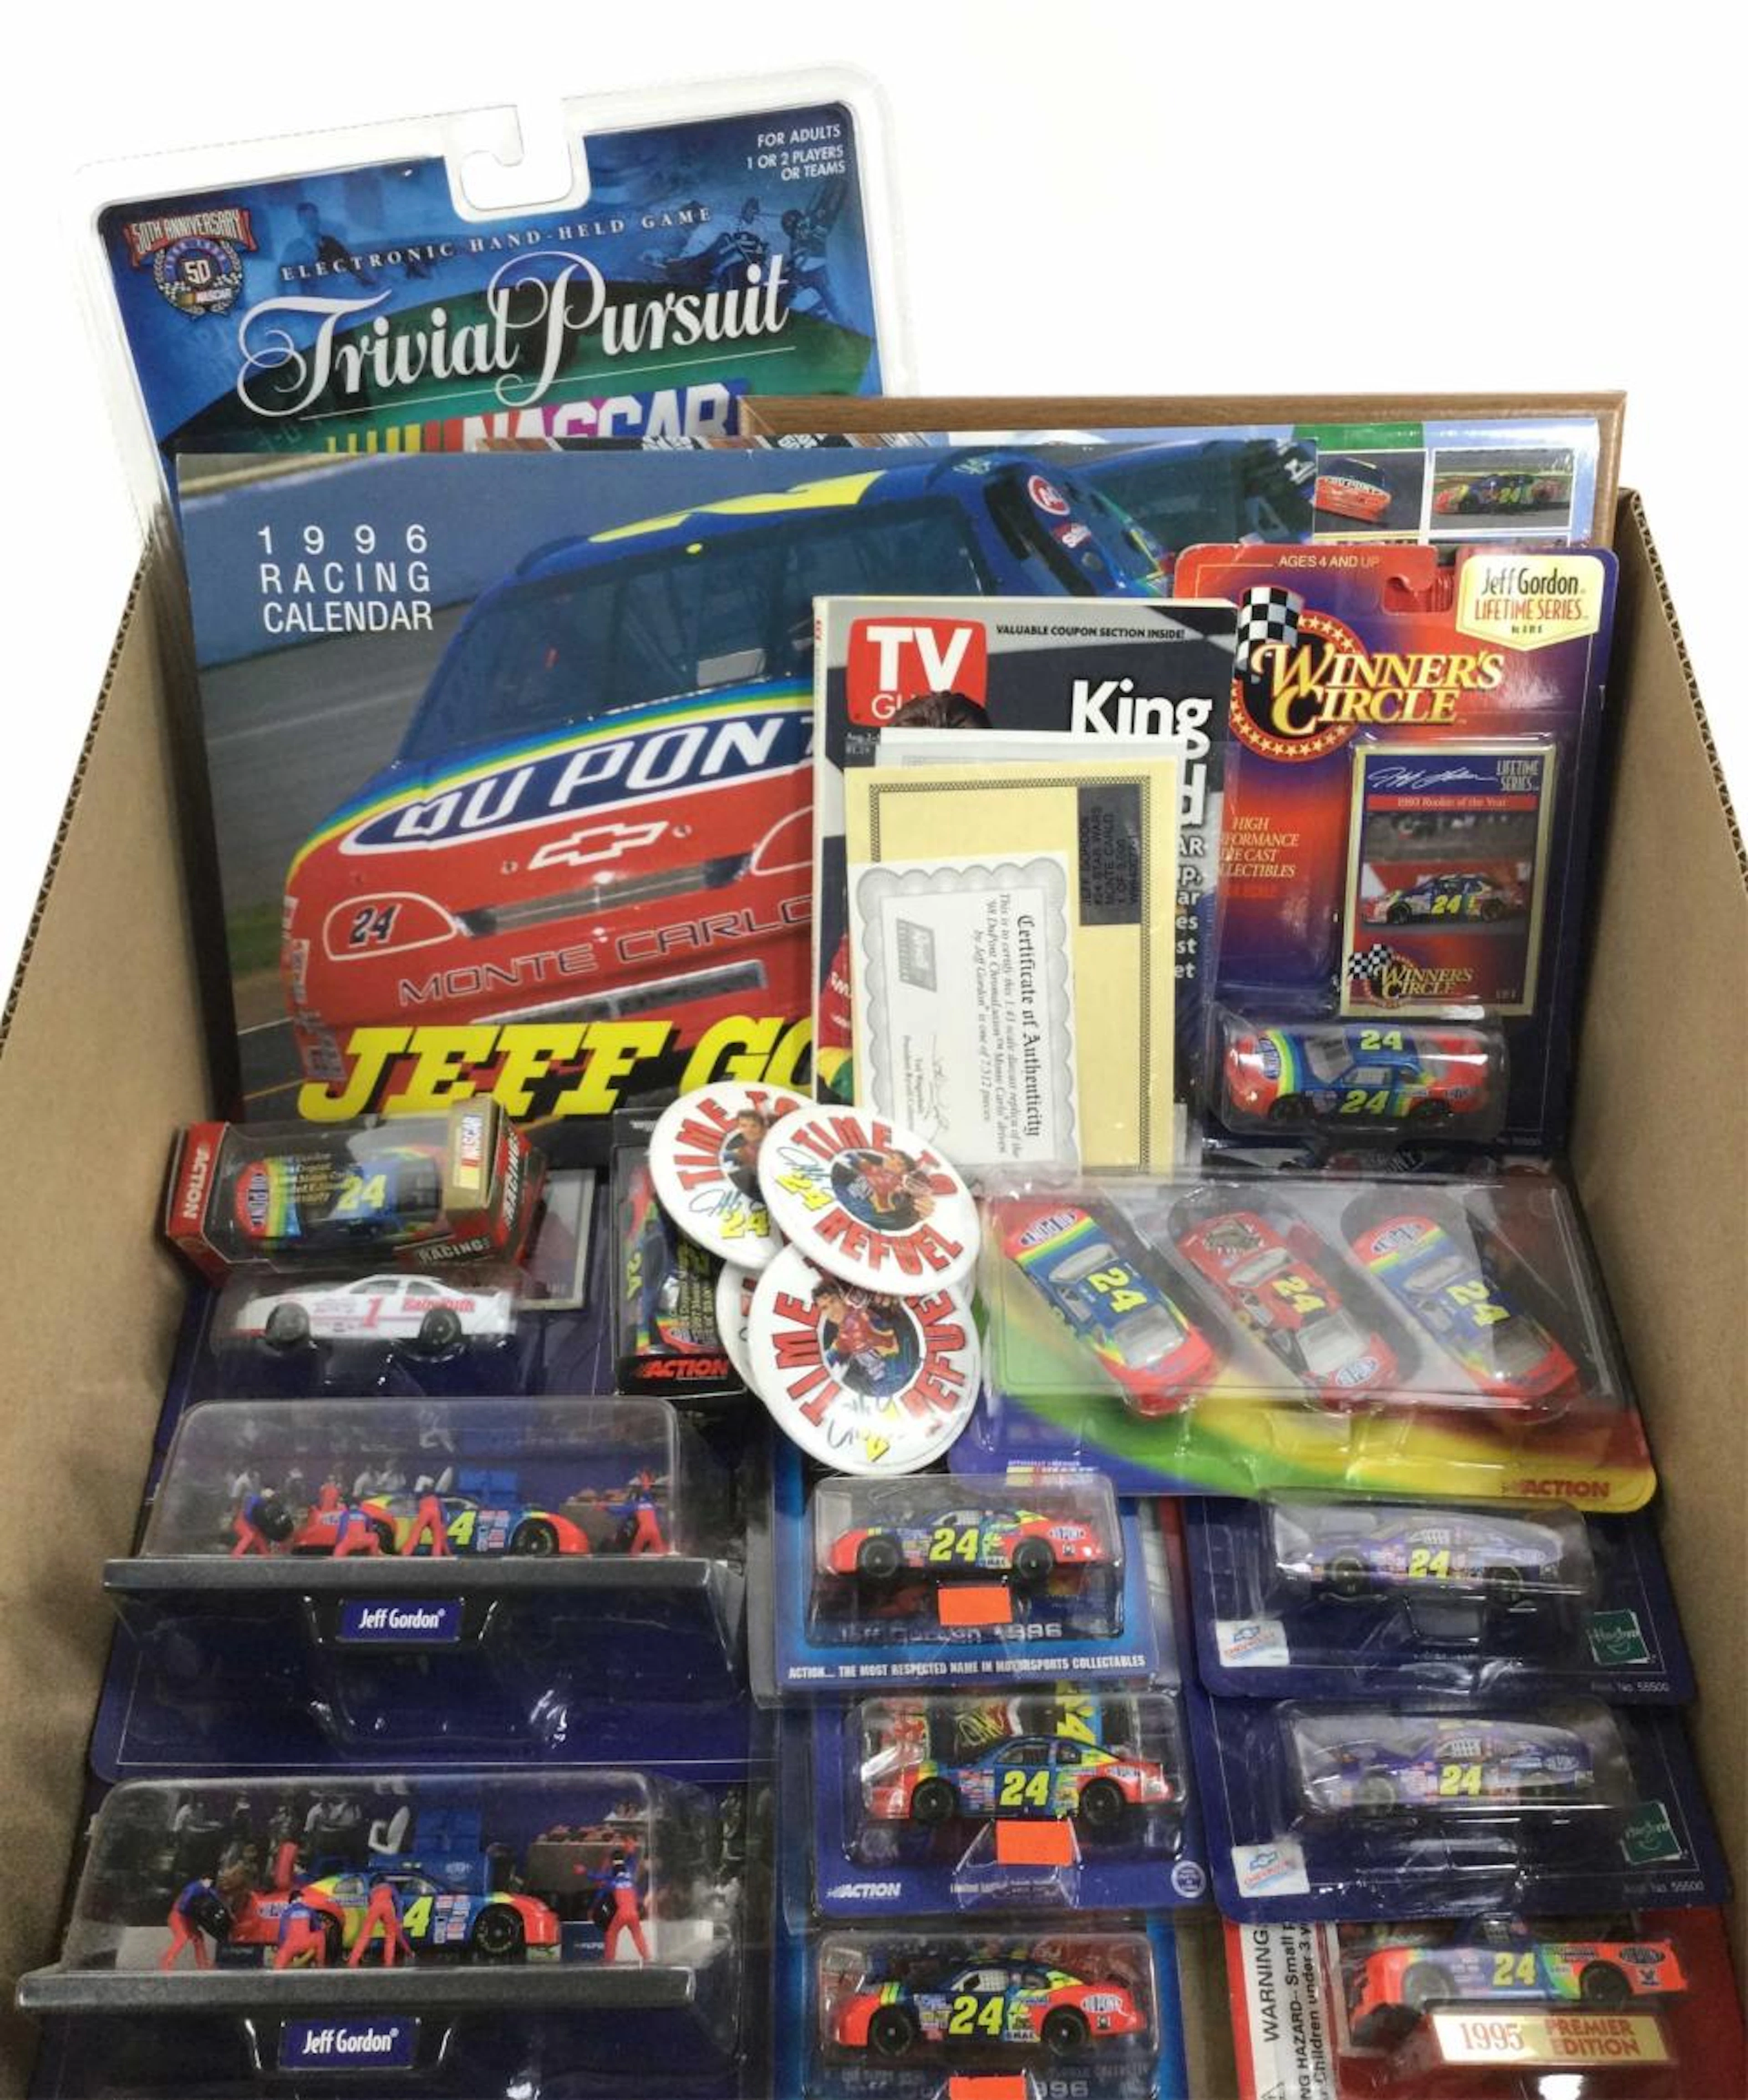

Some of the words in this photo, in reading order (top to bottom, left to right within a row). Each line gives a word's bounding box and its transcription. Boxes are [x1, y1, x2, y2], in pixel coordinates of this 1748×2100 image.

[757, 132, 784, 148] FOR
[790, 123, 841, 144] ADULTS
[747, 157, 753, 170] 1
[757, 153, 777, 168] OR
[781, 152, 790, 166] 2
[793, 145, 844, 164] PLAYERS
[781, 166, 801, 181] OR
[803, 161, 846, 178] TEAMS
[131, 221, 161, 254] 50TH
[164, 209, 244, 241] ANNIVERSARY
[281, 241, 453, 281] ELECTRONIC
[470, 219, 625, 253] HAND-HELD
[642, 207, 712, 229] GAME
[184, 260, 211, 284] 50
[237, 287, 520, 418] Trivial
[488, 251, 790, 407] Pursuit
[261, 561, 431, 594] RACING
[1279, 556, 1316, 568] AGES
[1318, 556, 1327, 567] 4
[1330, 556, 1357, 568] AND
[1361, 557, 1380, 568] UP
[1481, 567, 1516, 595] Jeff
[1518, 567, 1579, 595] Gordon
[264, 600, 433, 632] CALENDAR
[1475, 598, 1535, 620] LIFETIME
[1538, 598, 1582, 620] SERIES
[996, 624, 1049, 636] VALUABLE
[1051, 625, 1098, 637] COUPON
[1100, 627, 1145, 638] SECTION
[866, 626, 972, 692] TV
[1250, 642, 1504, 698] WINNER'S
[1070, 677, 1214, 760] King
[1272, 685, 1460, 736] CIRCLE
[1496, 759, 1540, 776] LIFETIME
[1500, 776, 1533, 791] SERIES
[1232, 817, 1270, 831] HIGH
[1245, 848, 1277, 862] CAST
[1431, 895, 1462, 914] 24
[349, 903, 402, 948] 24
[1017, 914, 1035, 1004] Certificate
[399, 943, 594, 1007] MONTE
[1021, 1010, 1039, 1030] of
[1360, 1030, 1403, 1050] 24
[297, 1020, 674, 1123] JEFF
[1022, 1032, 1042, 1137] Authenticity
[1340, 1090, 1389, 1114] 24
[674, 1097, 739, 1191] TIME
[791, 1117, 893, 1161] TIME
[183, 1144, 211, 1220] ACTION
[337, 1174, 388, 1210] 24
[720, 1209, 770, 1240] 24
[813, 1207, 964, 1275] REFUEL
[1088, 1267, 1148, 1313] 24
[1273, 1275, 1326, 1314] 24
[1447, 1279, 1511, 1327] 24
[642, 1359, 728, 1379] ACTION
[772, 1291, 841, 1427] TIME
[1519, 1480, 1610, 1498] ACTION
[929, 1528, 978, 1561] 24
[1408, 1549, 1450, 1579] 24
[359, 1608, 386, 1630] Jeff
[838, 1665, 858, 1678] THE
[860, 1664, 889, 1677] MOST
[891, 1661, 947, 1677] RESPECTED
[950, 1661, 980, 1675] NAME
[981, 1661, 993, 1674] IN
[995, 1657, 1069, 1672] MOTORSPORTS
[1072, 1655, 1146, 1670] COLLECTABLES
[999, 1770, 1051, 1806] 24
[1439, 1764, 1483, 1795] 24
[840, 1883, 902, 1899] ACTION
[1281, 1937, 1298, 1985] Small
[1299, 1942, 1310, 1951] 3
[1304, 1956, 1316, 2004] under
[1492, 1952, 1537, 1986] 24
[949, 1996, 1004, 2035] 24
[1545, 2018, 1635, 2035] PREMIER
[303, 2030, 334, 2054] Jeff
[1458, 2021, 1525, 2051] 1995
[1551, 2037, 1640, 2055] EDITION
